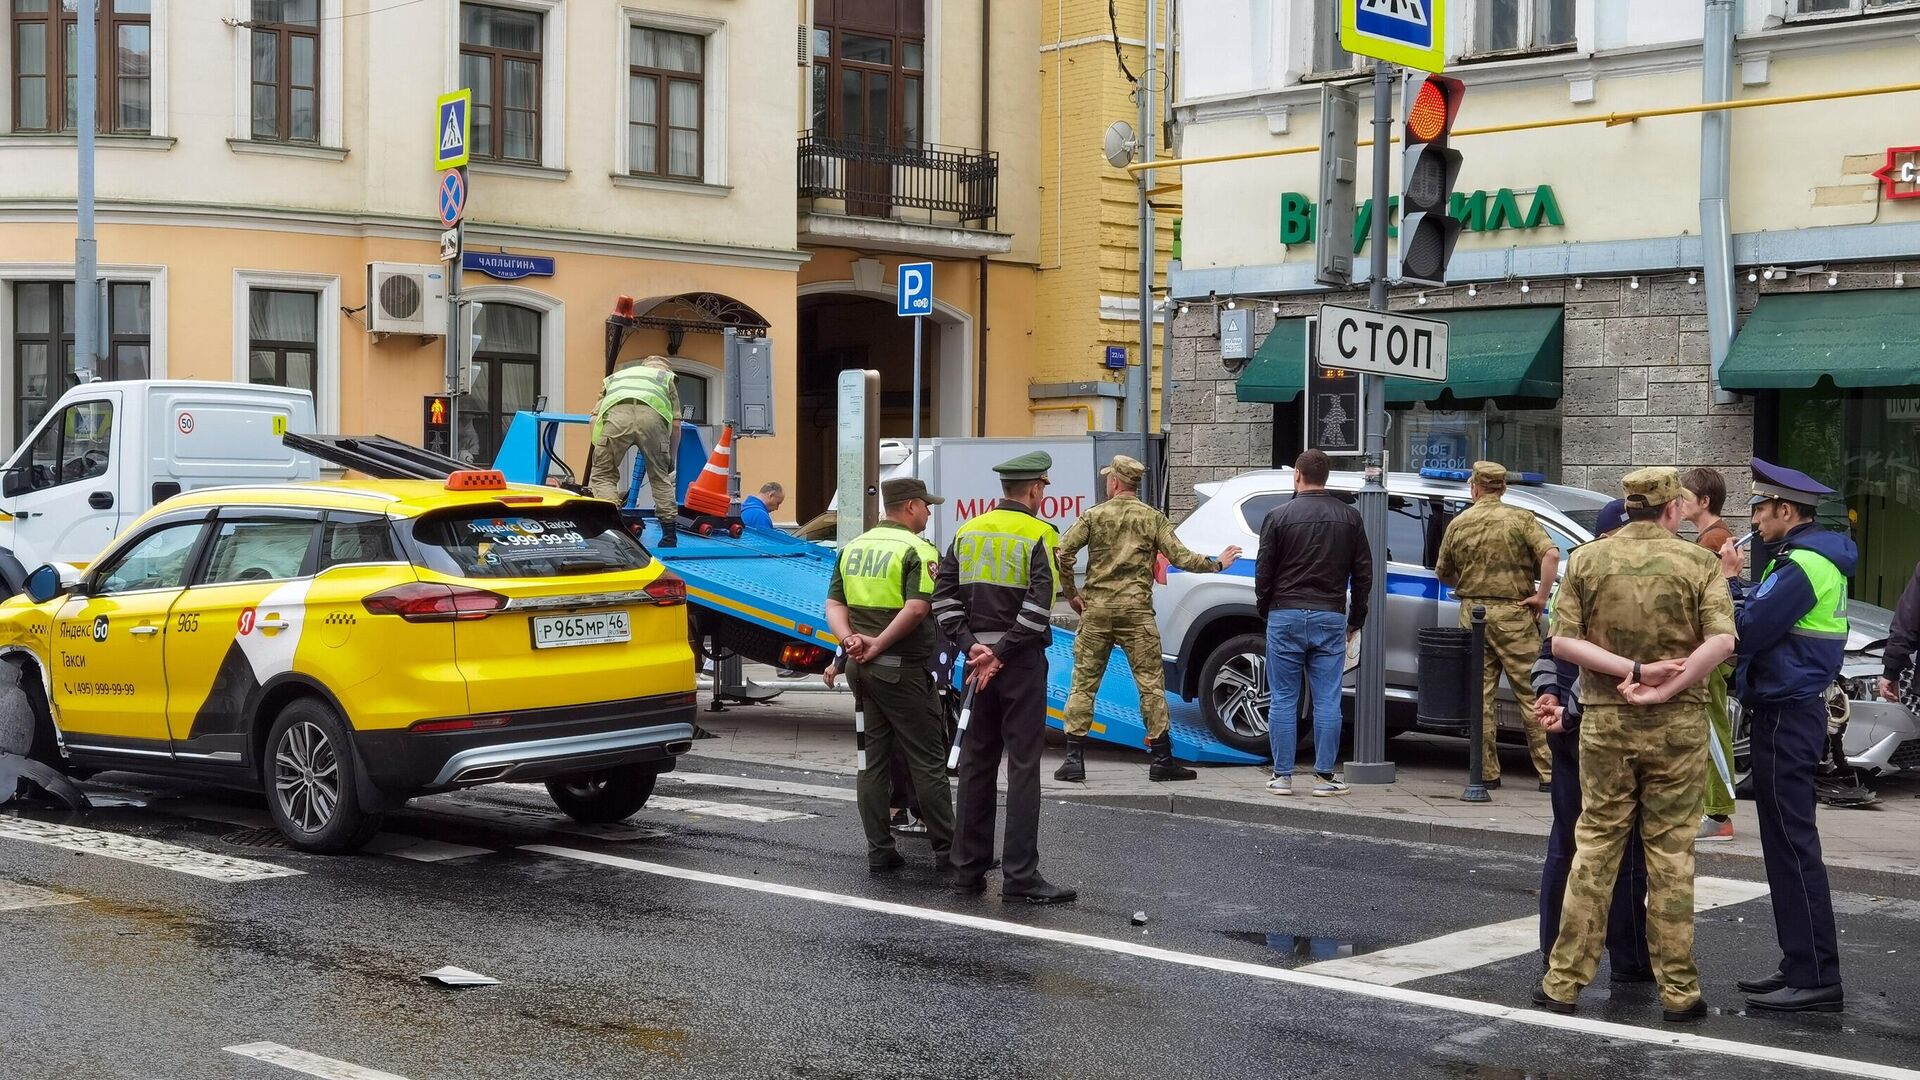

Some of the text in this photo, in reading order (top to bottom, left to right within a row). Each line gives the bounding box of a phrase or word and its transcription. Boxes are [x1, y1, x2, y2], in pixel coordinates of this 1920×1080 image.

[478, 257, 536, 270] ЧАПЛЫГИНА
[904, 269, 923, 310] P
[1338, 317, 1432, 369] СТОП
[181, 418, 192, 429] 50
[1411, 444, 1448, 456] КОФЕ
[1410, 456, 1466, 470] С СОБОЙ
[956, 495, 1086, 521] МИОРГ
[467, 523, 520, 534] Яндекс
[540, 520, 577, 530] Такси
[507, 532, 584, 546] 999-99-99
[845, 548, 893, 579] ВАИ
[960, 537, 1025, 581] ВАИ
[60, 618, 108, 640] Яндекс Go
[177, 613, 200, 632] 965
[240, 610, 253, 632] Я
[61, 651, 86, 668] Такси
[74, 683, 135, 696] (495) 999-99-99
